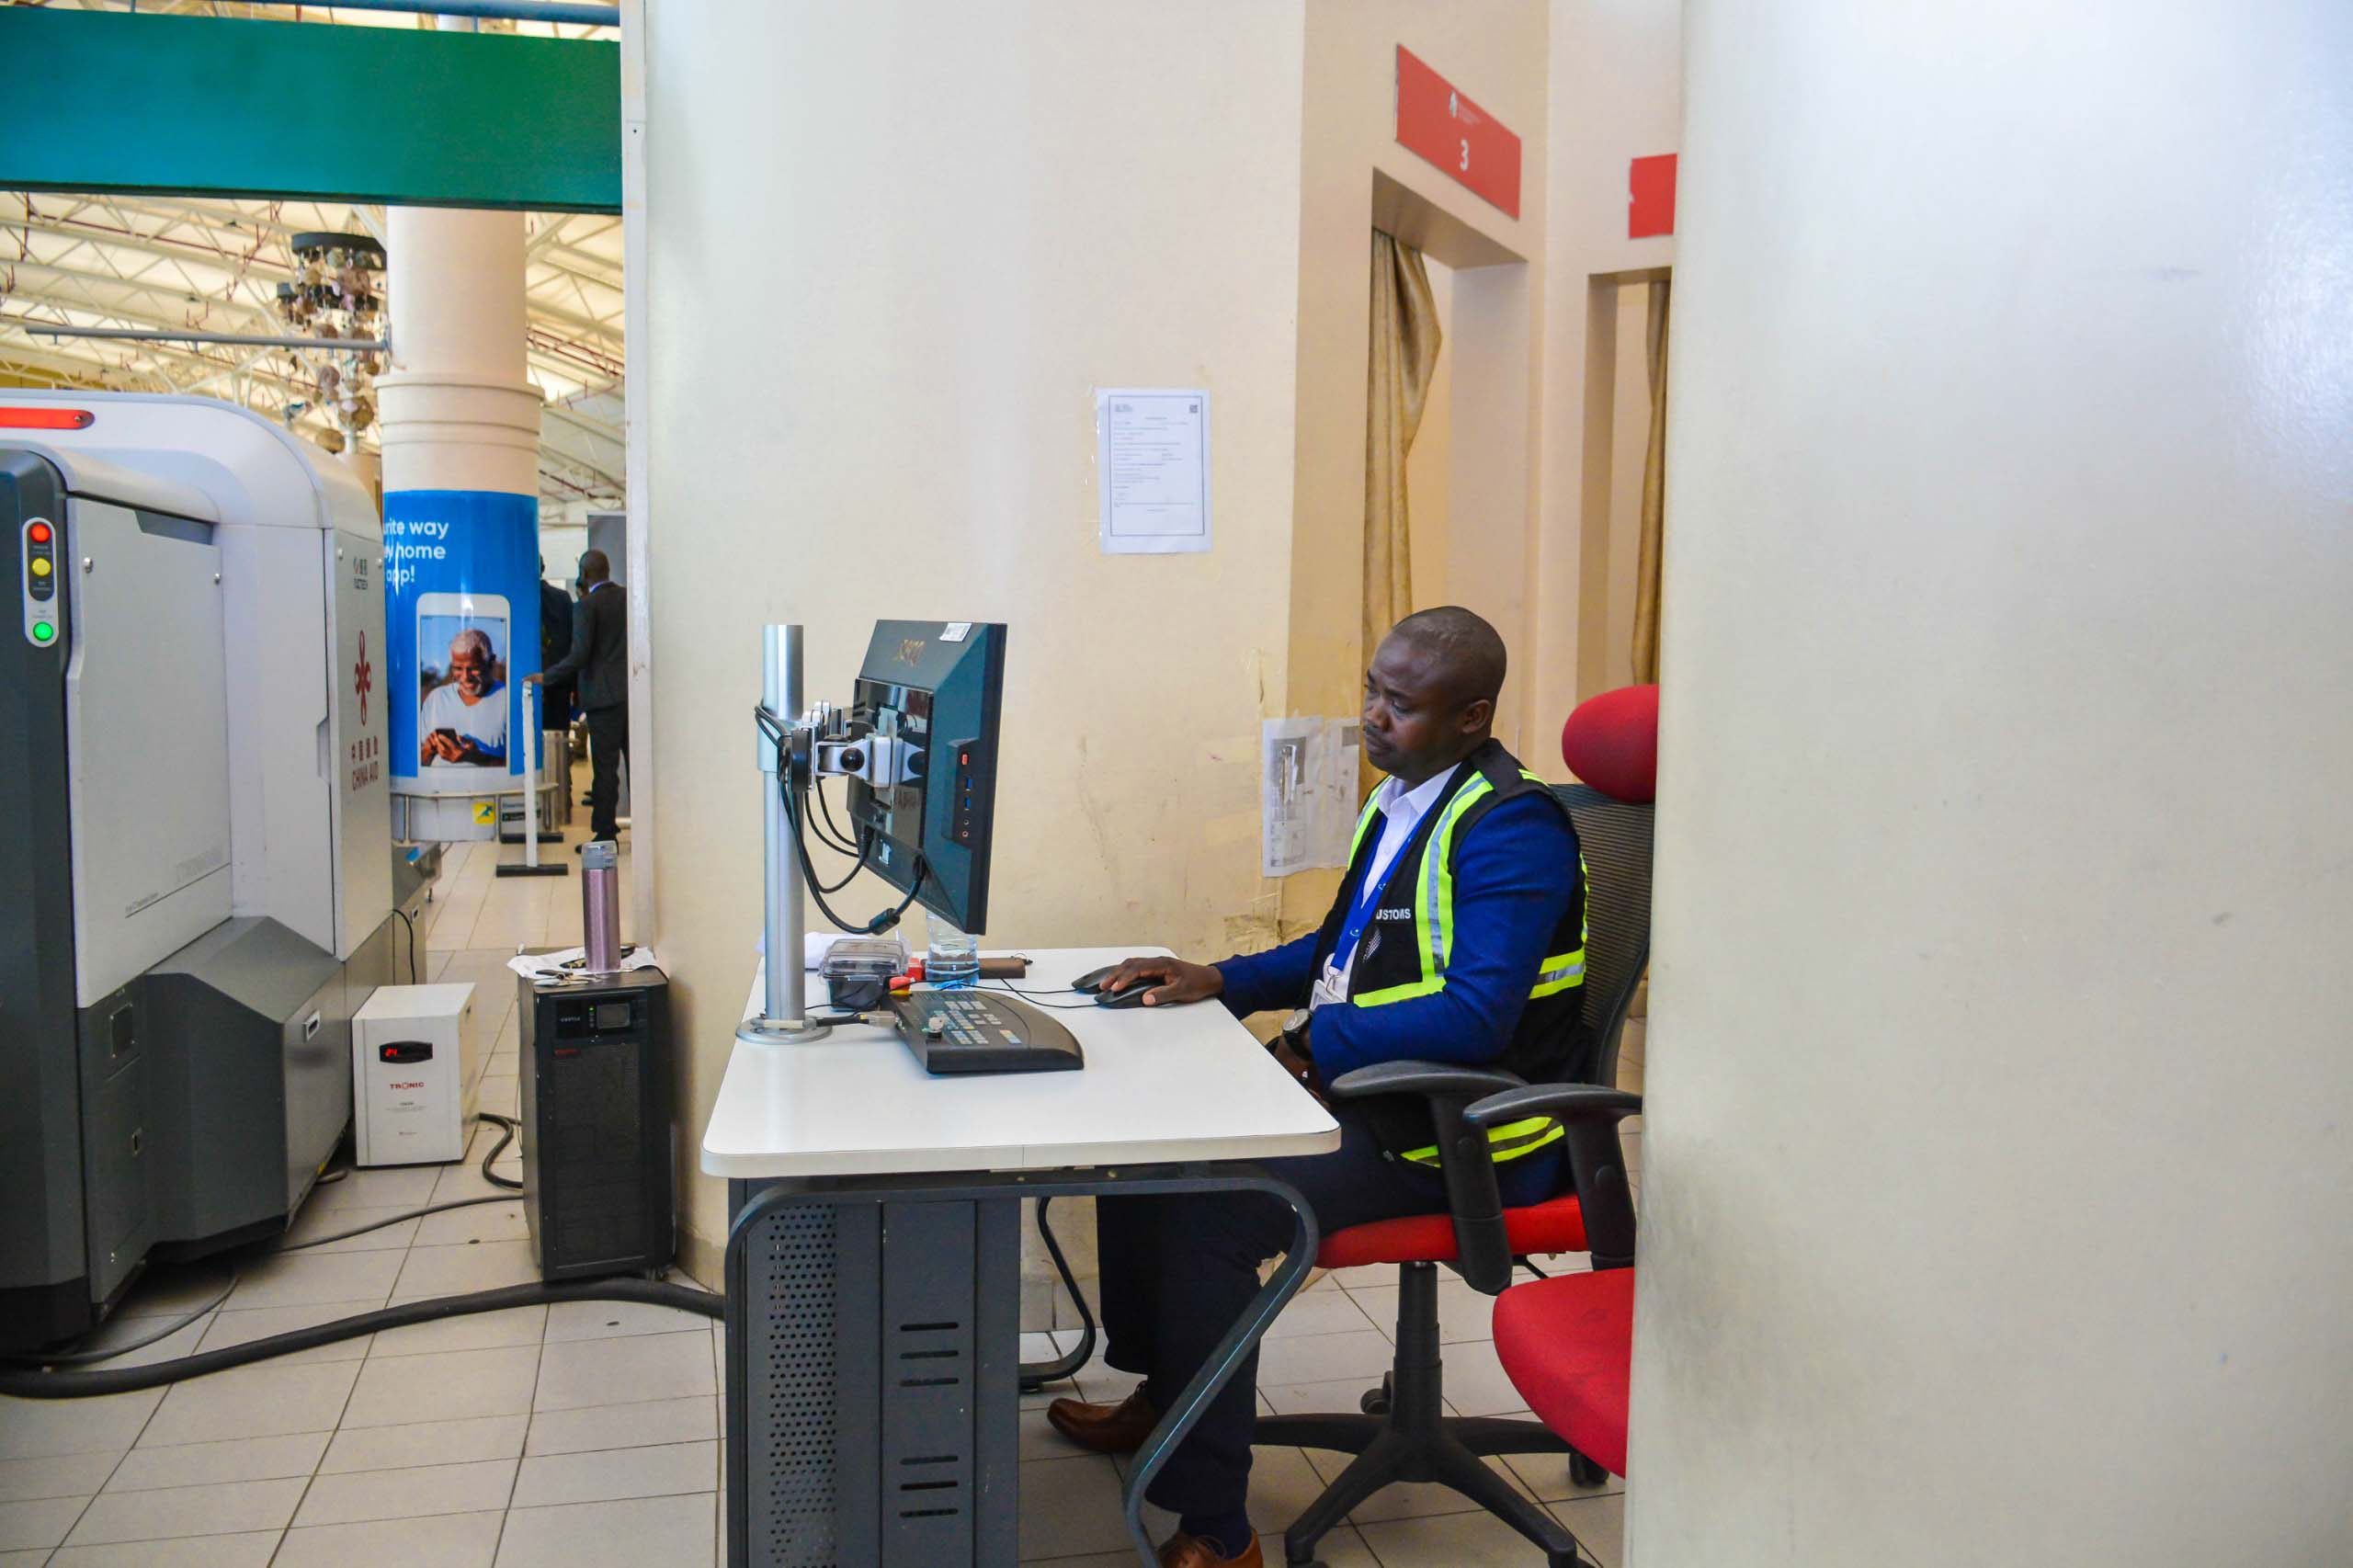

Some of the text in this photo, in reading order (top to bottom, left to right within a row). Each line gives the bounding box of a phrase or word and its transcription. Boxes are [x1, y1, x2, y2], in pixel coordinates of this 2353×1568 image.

[1459, 139, 1470, 171] 3
[409, 520, 449, 540] way
[395, 541, 446, 559] home
[386, 564, 415, 586] app!
[390, 1081, 425, 1090] TRONIC
